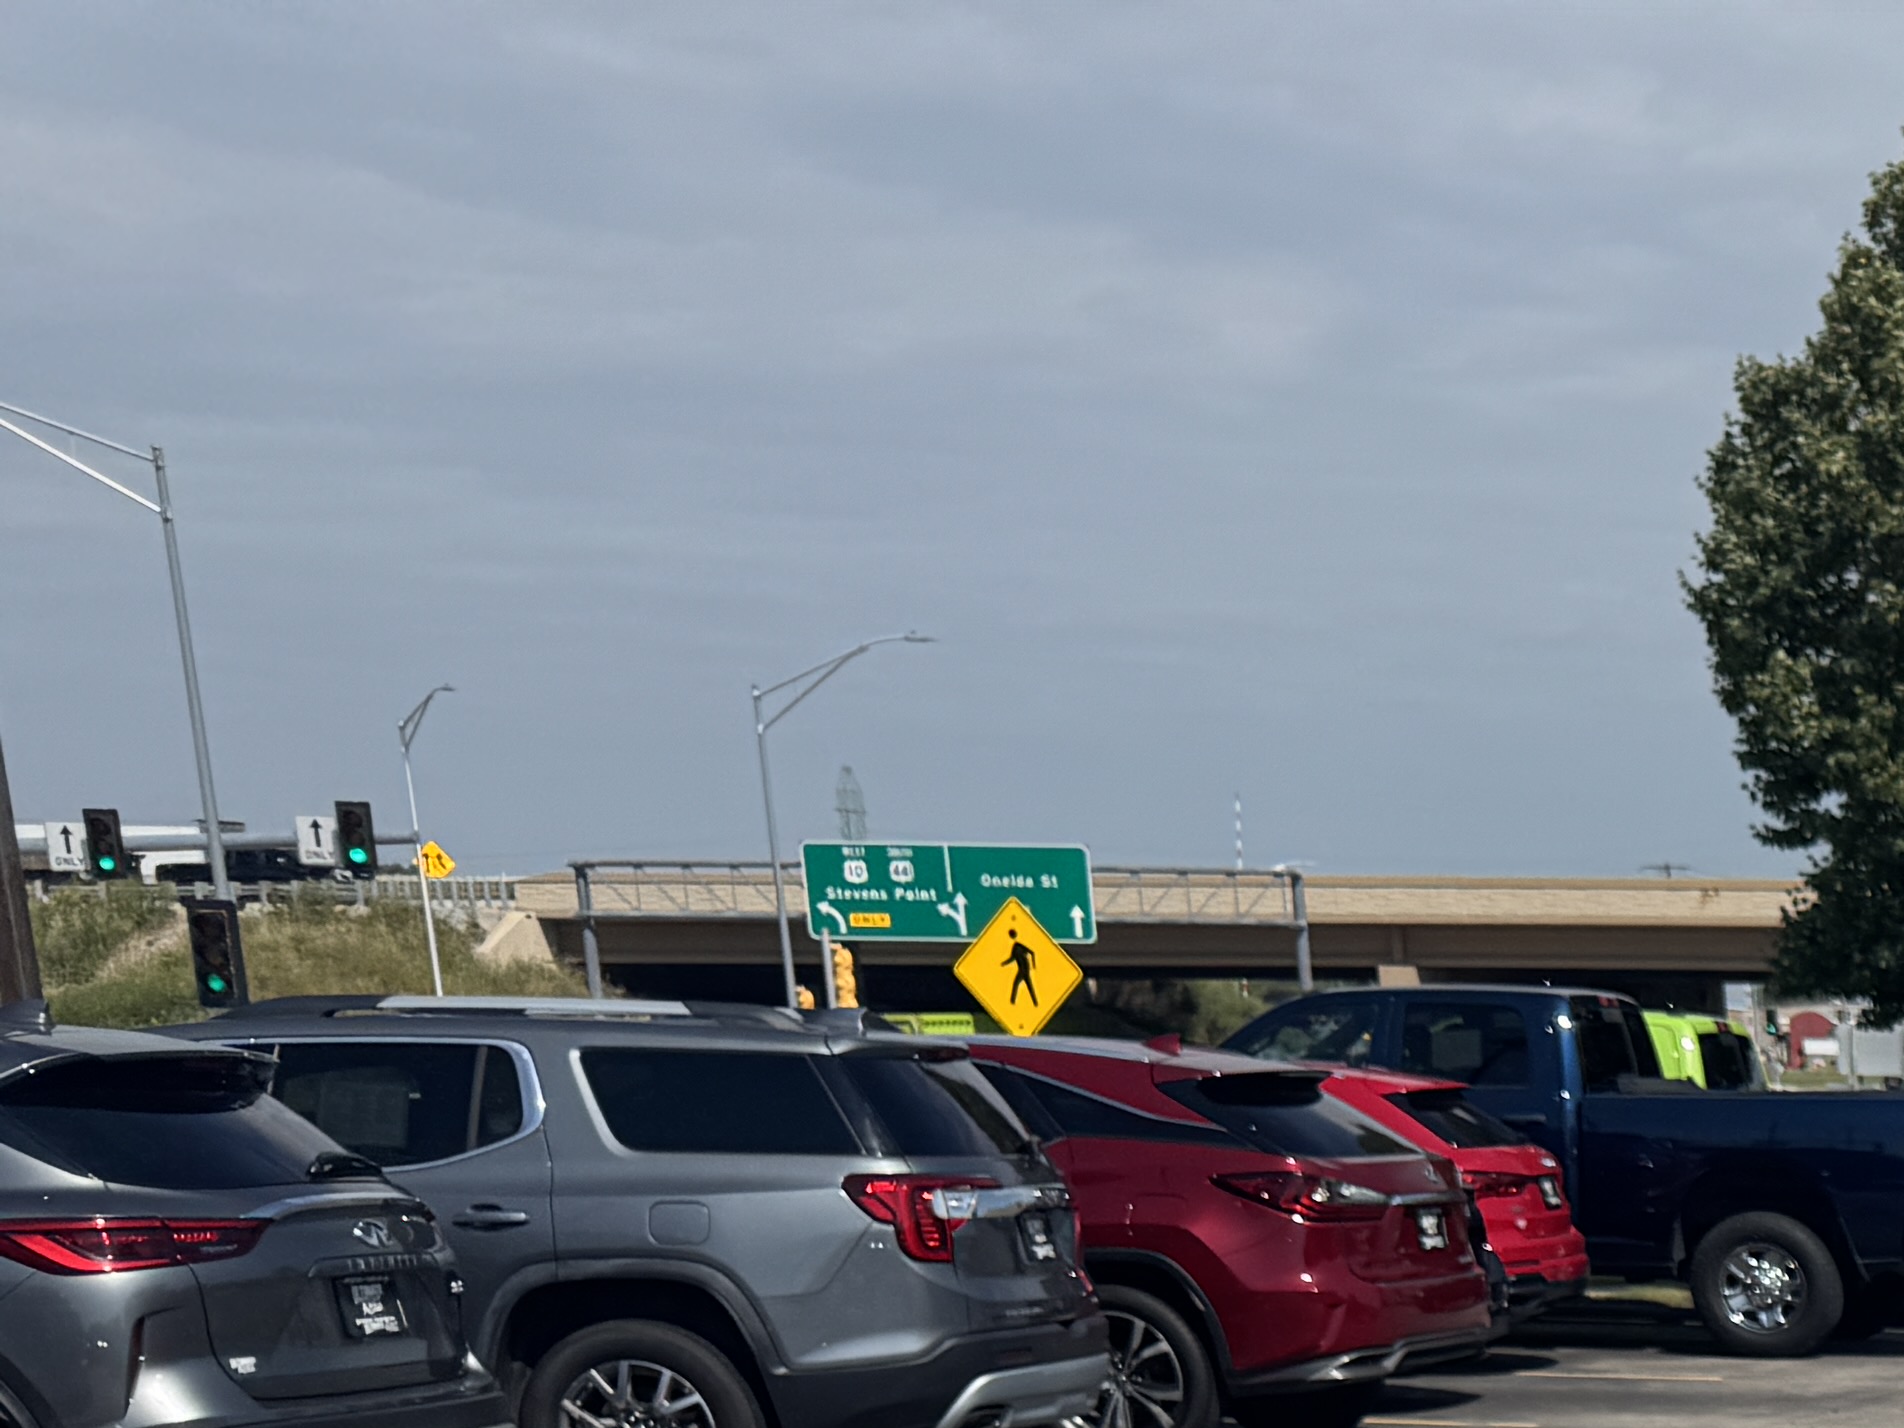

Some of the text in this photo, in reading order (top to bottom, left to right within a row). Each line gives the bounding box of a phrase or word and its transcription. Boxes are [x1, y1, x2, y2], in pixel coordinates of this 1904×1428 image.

[849, 864, 863, 878] 10
[980, 873, 1058, 889] Oneida St
[825, 885, 937, 901] Stevens Point
